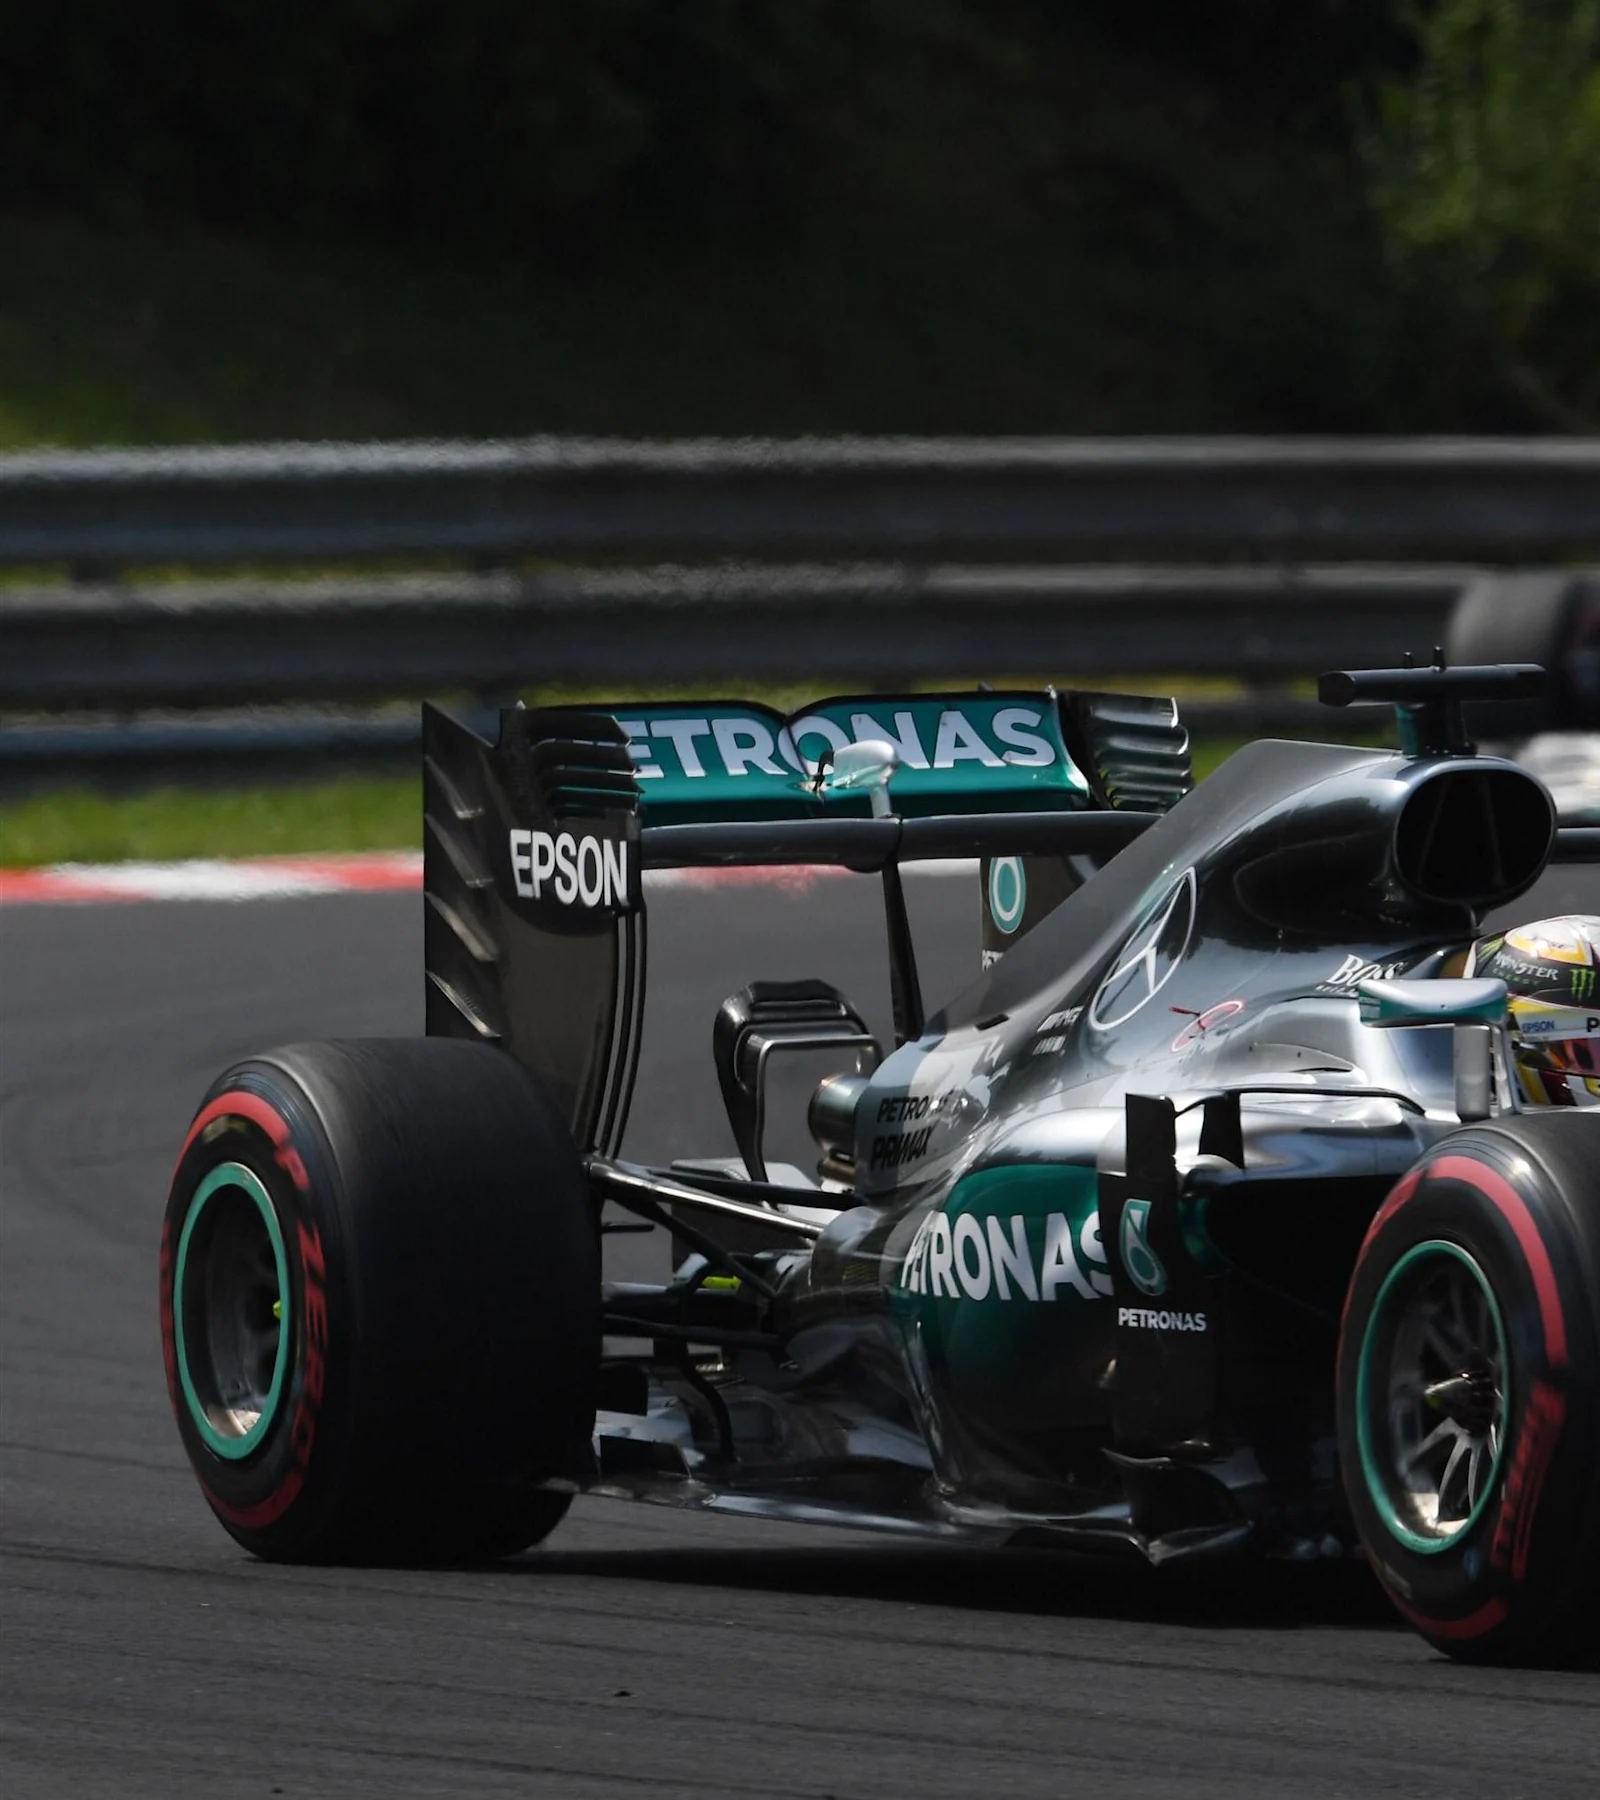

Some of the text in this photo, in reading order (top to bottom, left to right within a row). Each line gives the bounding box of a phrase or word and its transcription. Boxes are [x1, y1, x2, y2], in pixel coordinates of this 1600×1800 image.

[619, 707, 1056, 779] ETRONAS
[510, 828, 629, 907] EPSON
[1494, 950, 1559, 980] MONSTER
[1117, 1306, 1207, 1332] PETRONAS
